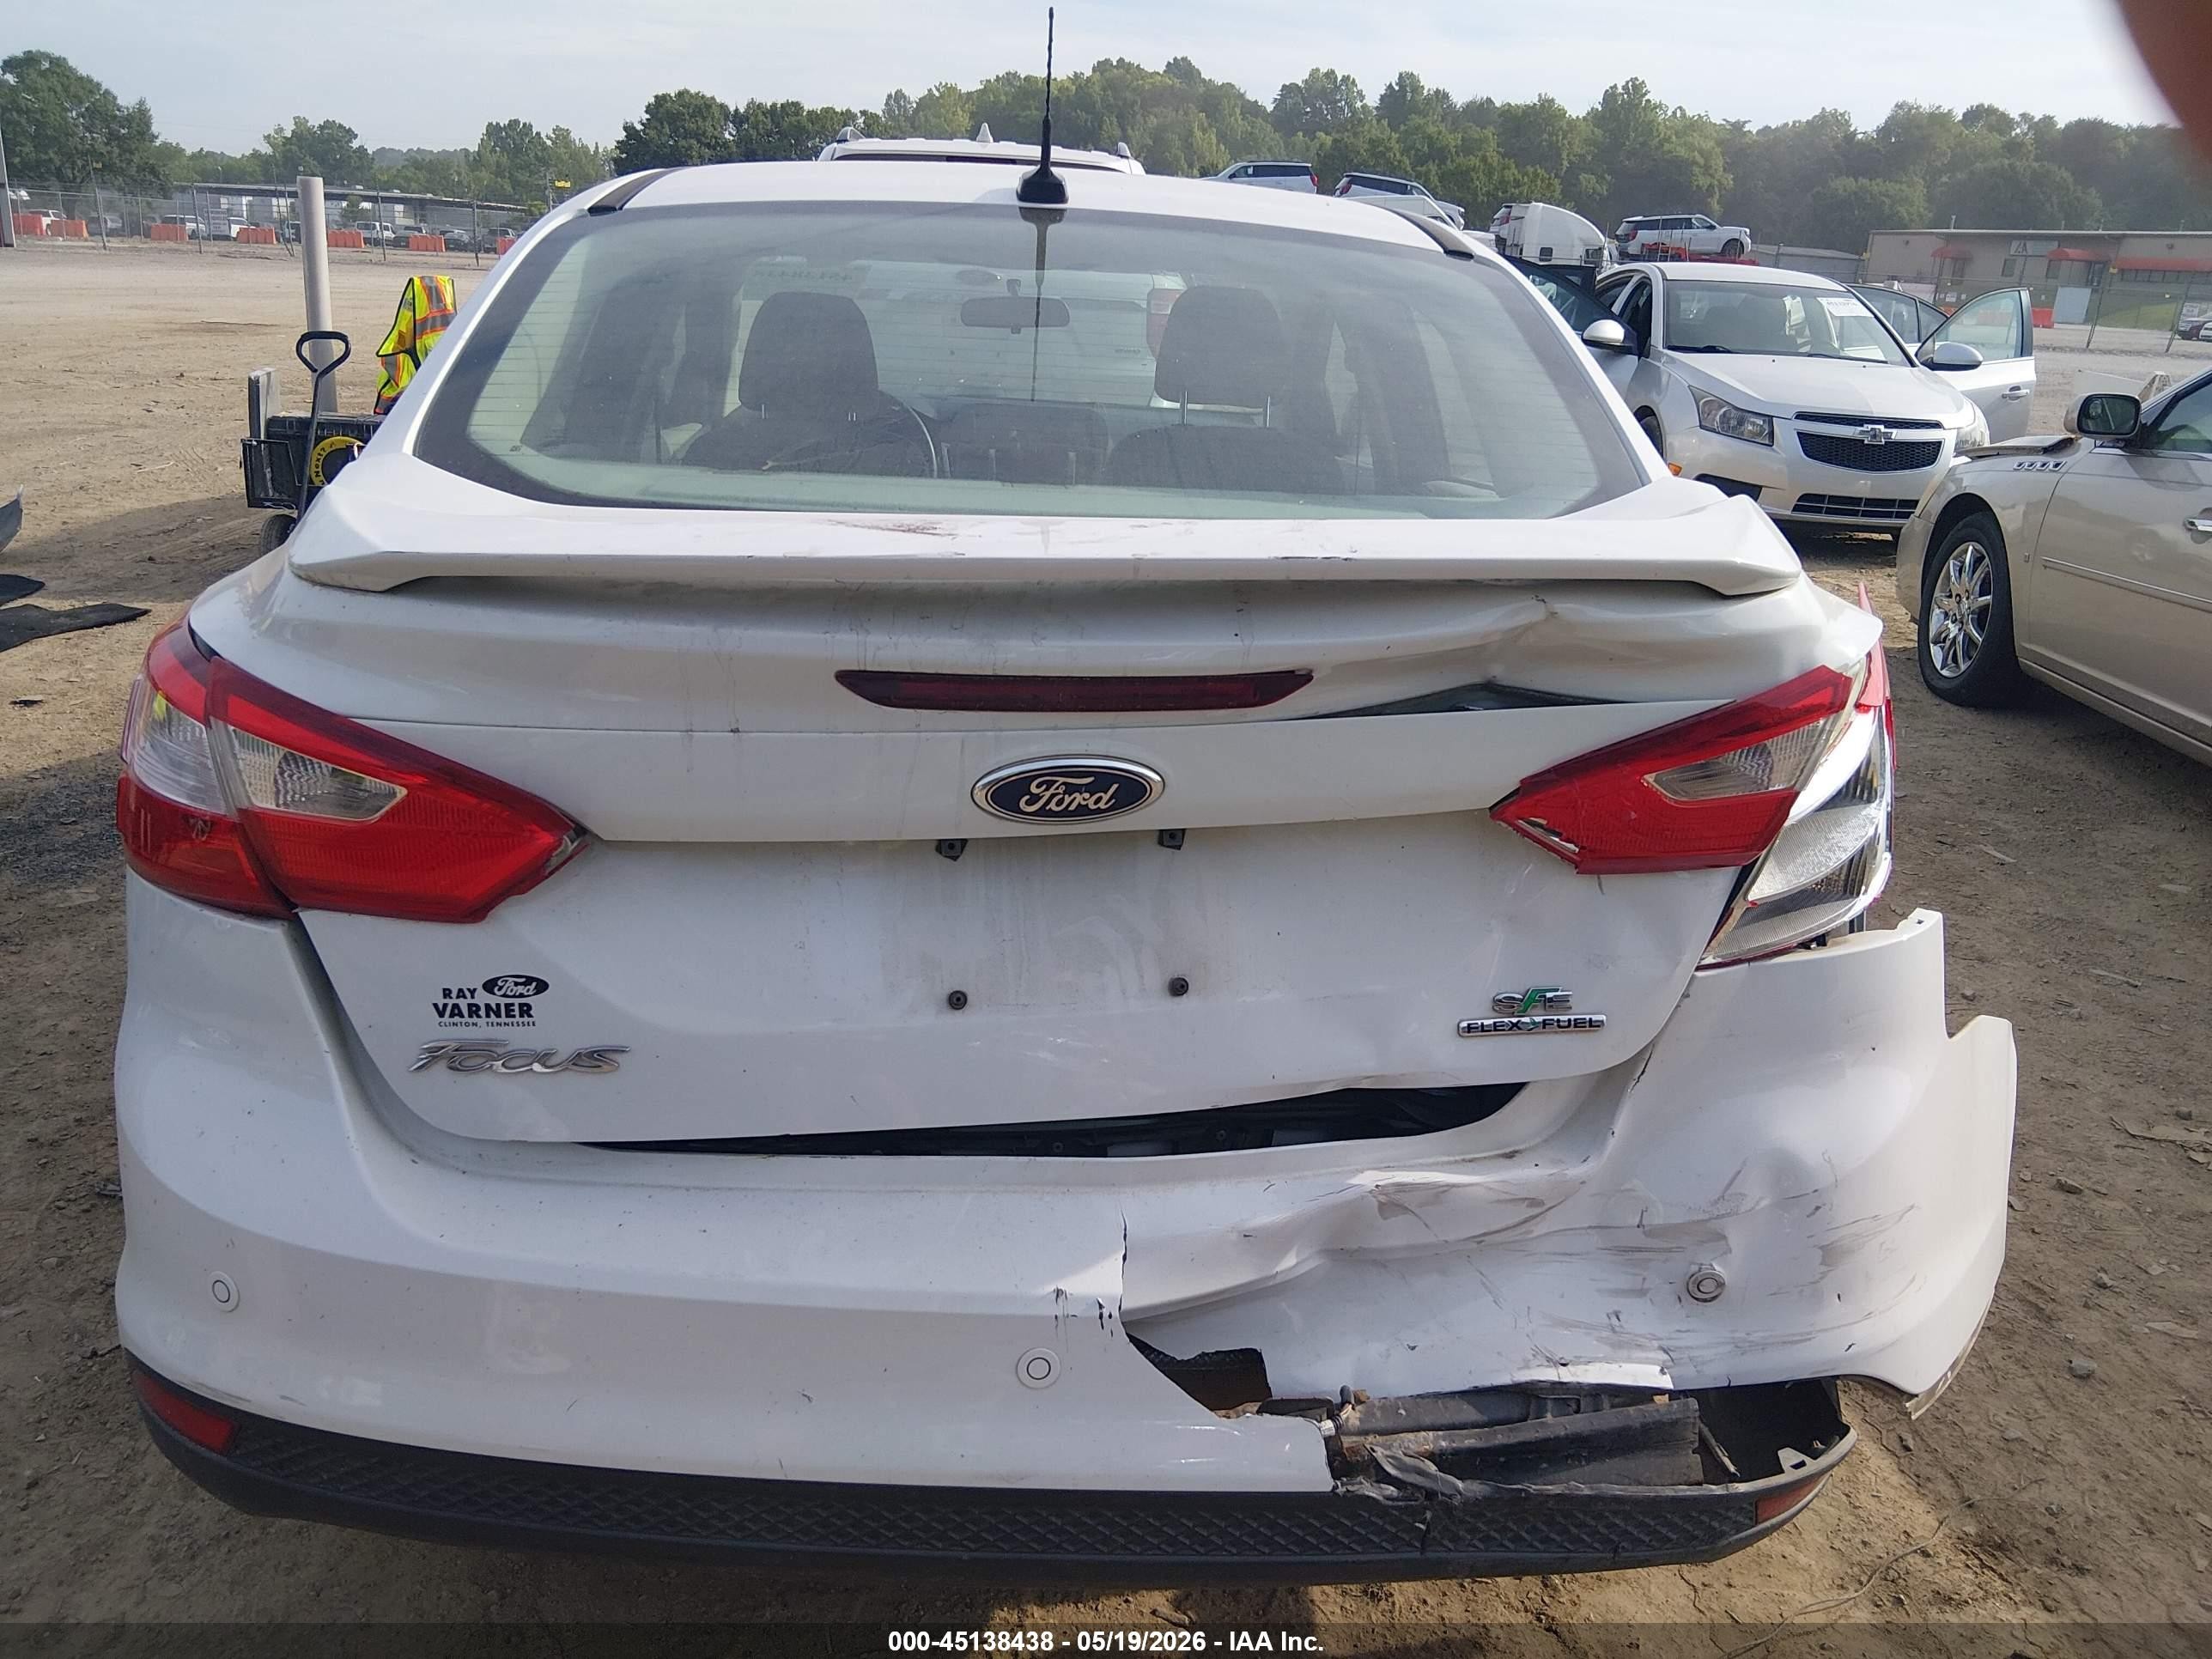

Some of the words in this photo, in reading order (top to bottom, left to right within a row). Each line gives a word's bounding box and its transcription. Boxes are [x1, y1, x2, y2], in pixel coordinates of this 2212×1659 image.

[1018, 776, 1119, 812] Ford
[442, 988, 478, 1000] RAY
[494, 976, 538, 997] Ford
[1492, 987, 1574, 1015] SFE
[433, 1002, 535, 1019] VARNER
[438, 1020, 482, 1029] CLINTON,
[1466, 1019, 1522, 1034] FLEX
[1541, 1017, 1601, 1030] FUEL
